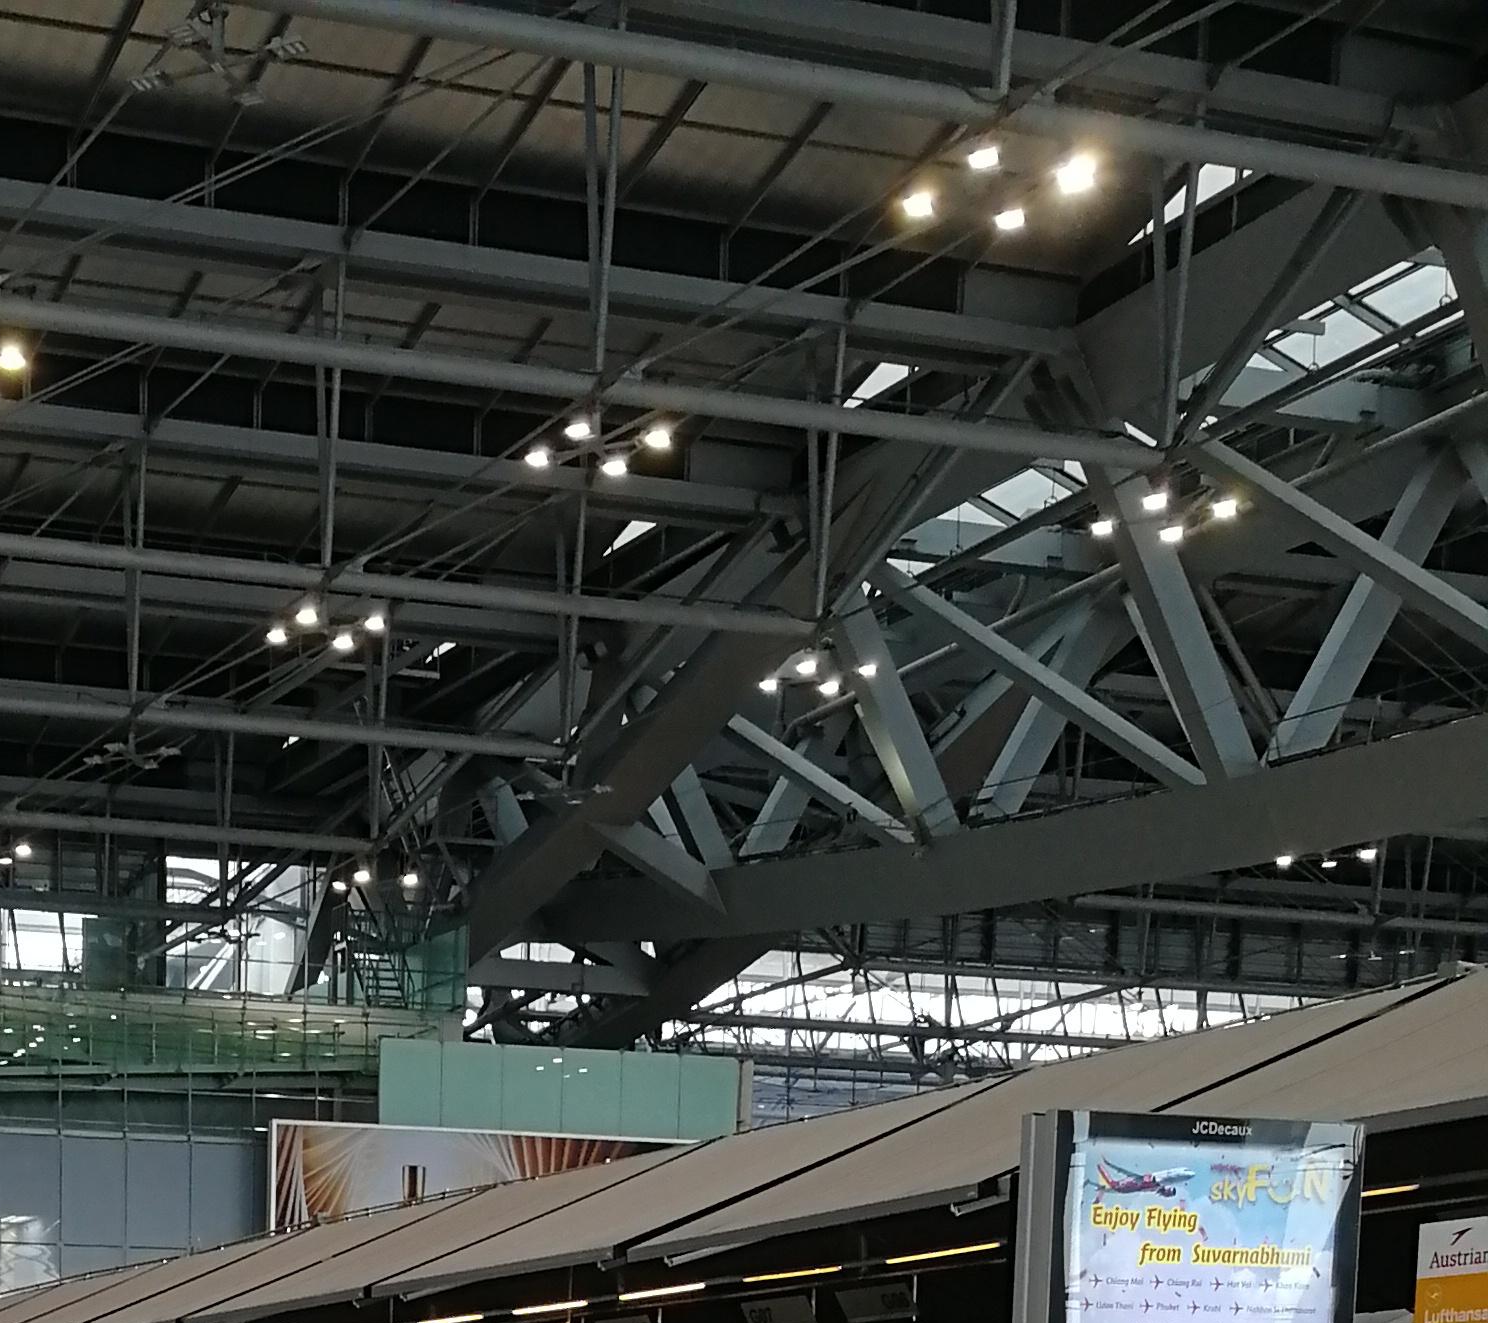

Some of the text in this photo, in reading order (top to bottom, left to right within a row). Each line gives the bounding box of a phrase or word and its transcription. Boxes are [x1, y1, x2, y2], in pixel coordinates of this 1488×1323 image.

[1192, 1120, 1253, 1137] JCDecaux
[1091, 1205, 1199, 1233] Enjoy Flying
[1138, 1243, 1312, 1267] from Suvarnabhumi
